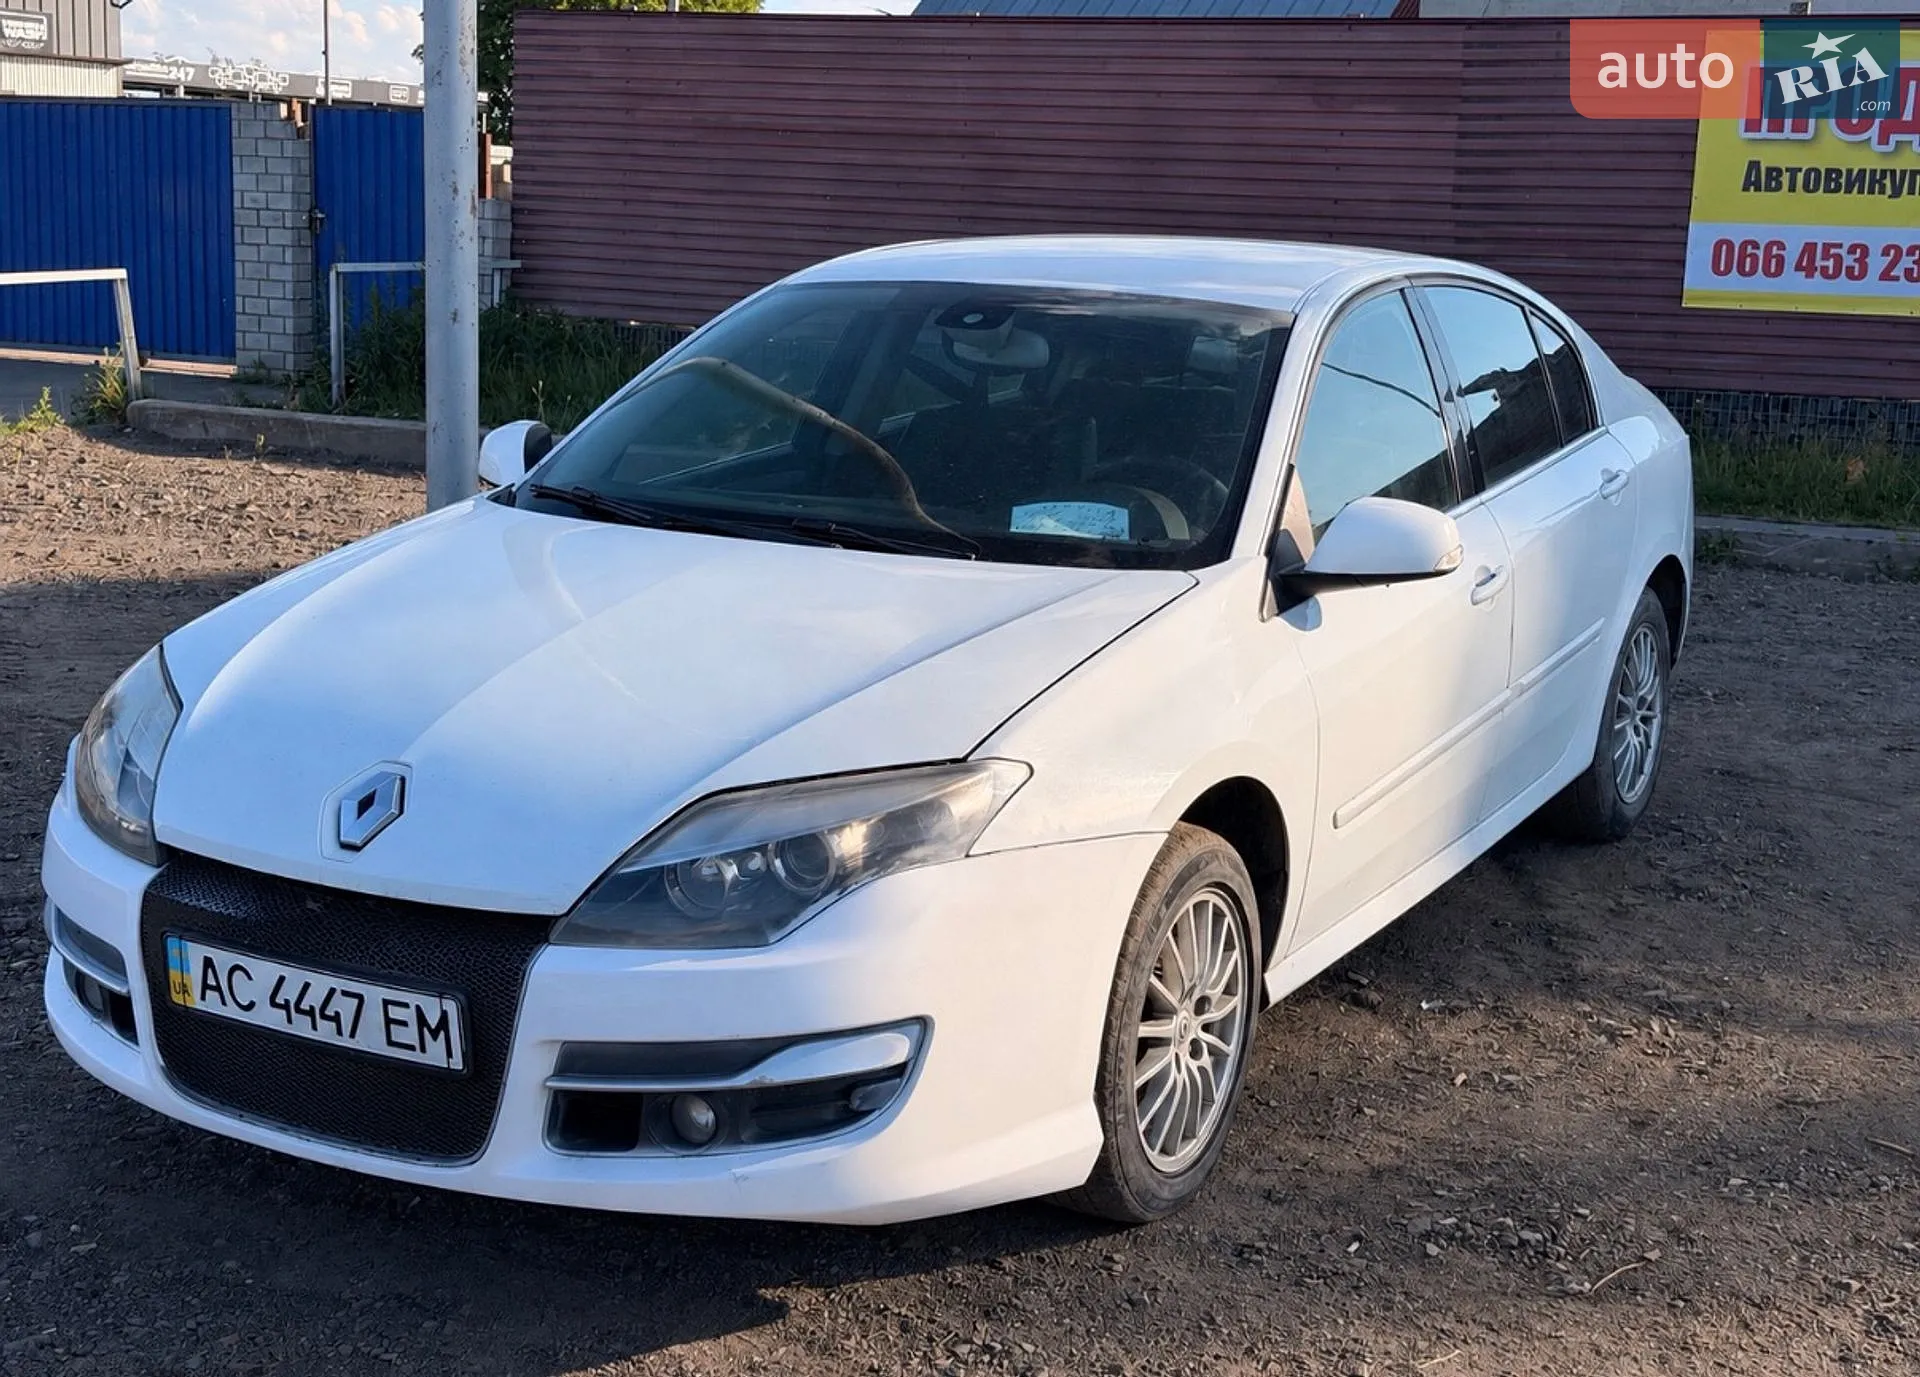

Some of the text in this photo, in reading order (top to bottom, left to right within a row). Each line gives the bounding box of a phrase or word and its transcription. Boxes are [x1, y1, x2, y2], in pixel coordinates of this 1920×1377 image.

[1711, 239, 1920, 283] 066 453 23
[173, 979, 191, 998] UA
[200, 955, 453, 1059] AC 4447 EM
